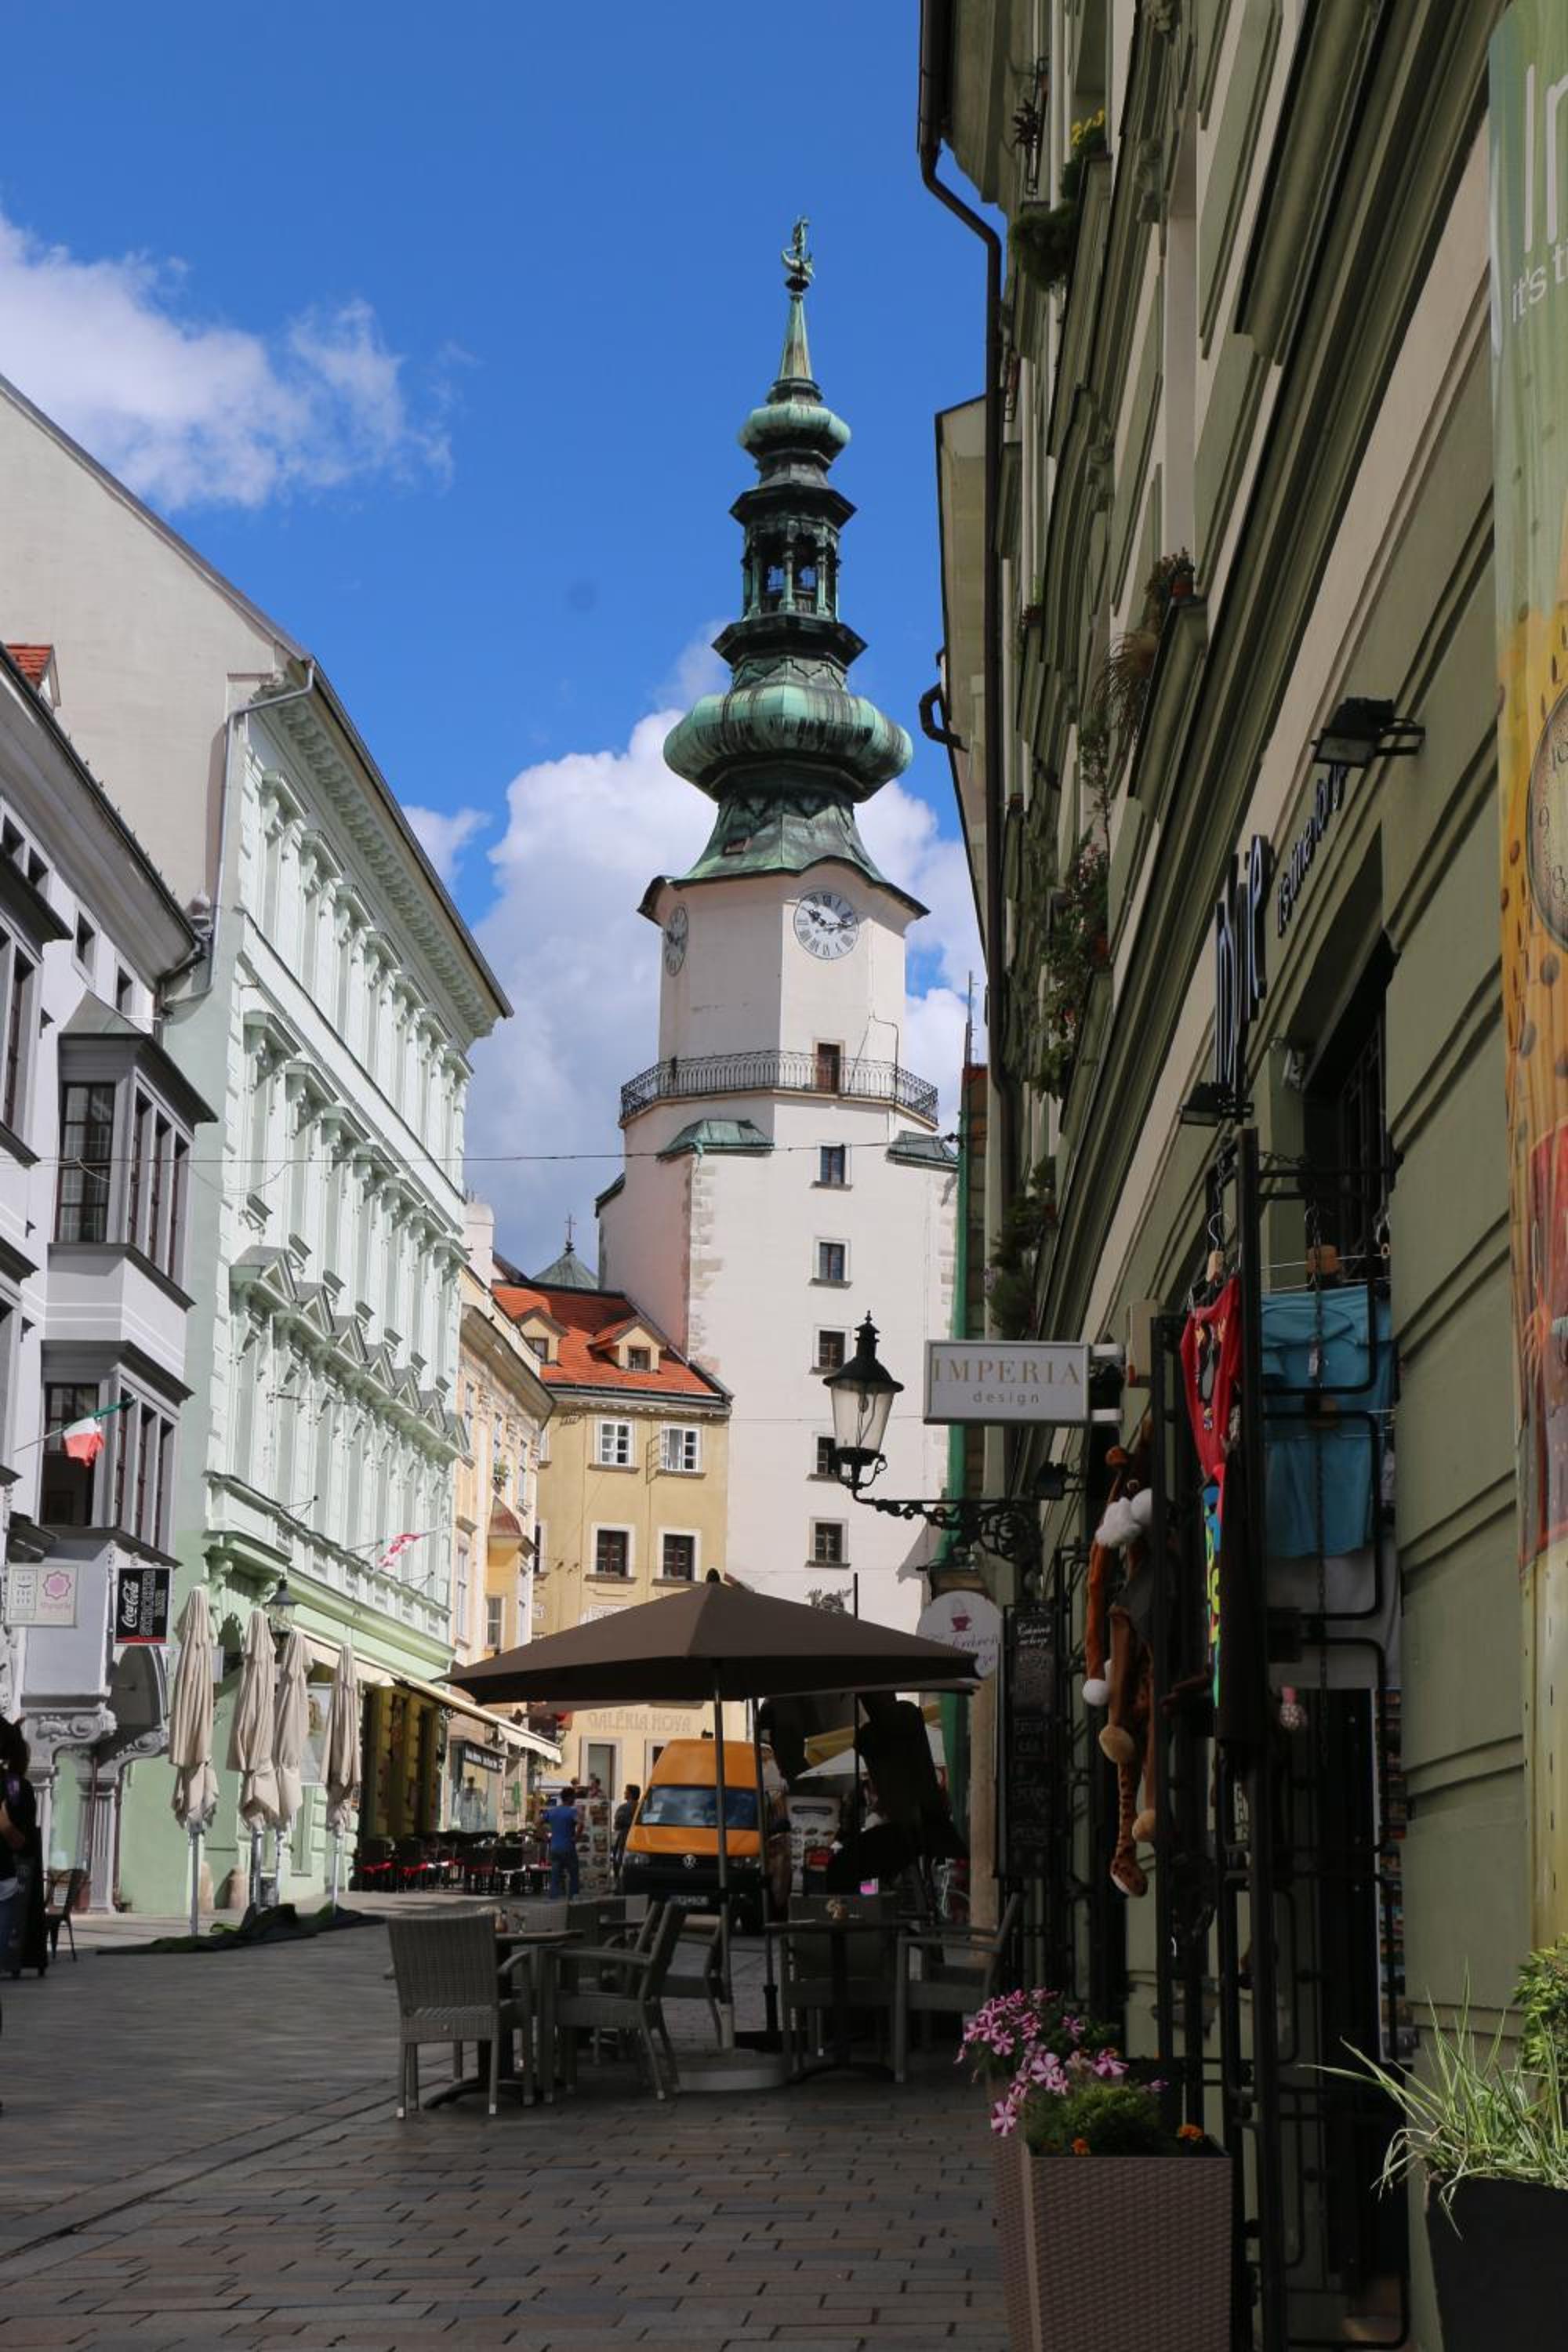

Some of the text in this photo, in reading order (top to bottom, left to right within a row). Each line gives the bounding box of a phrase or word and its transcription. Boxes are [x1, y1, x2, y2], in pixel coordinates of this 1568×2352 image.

[1512, 264, 1547, 323] it's
[933, 1359, 1080, 1385] IMPERIA
[972, 1390, 1040, 1406] design
